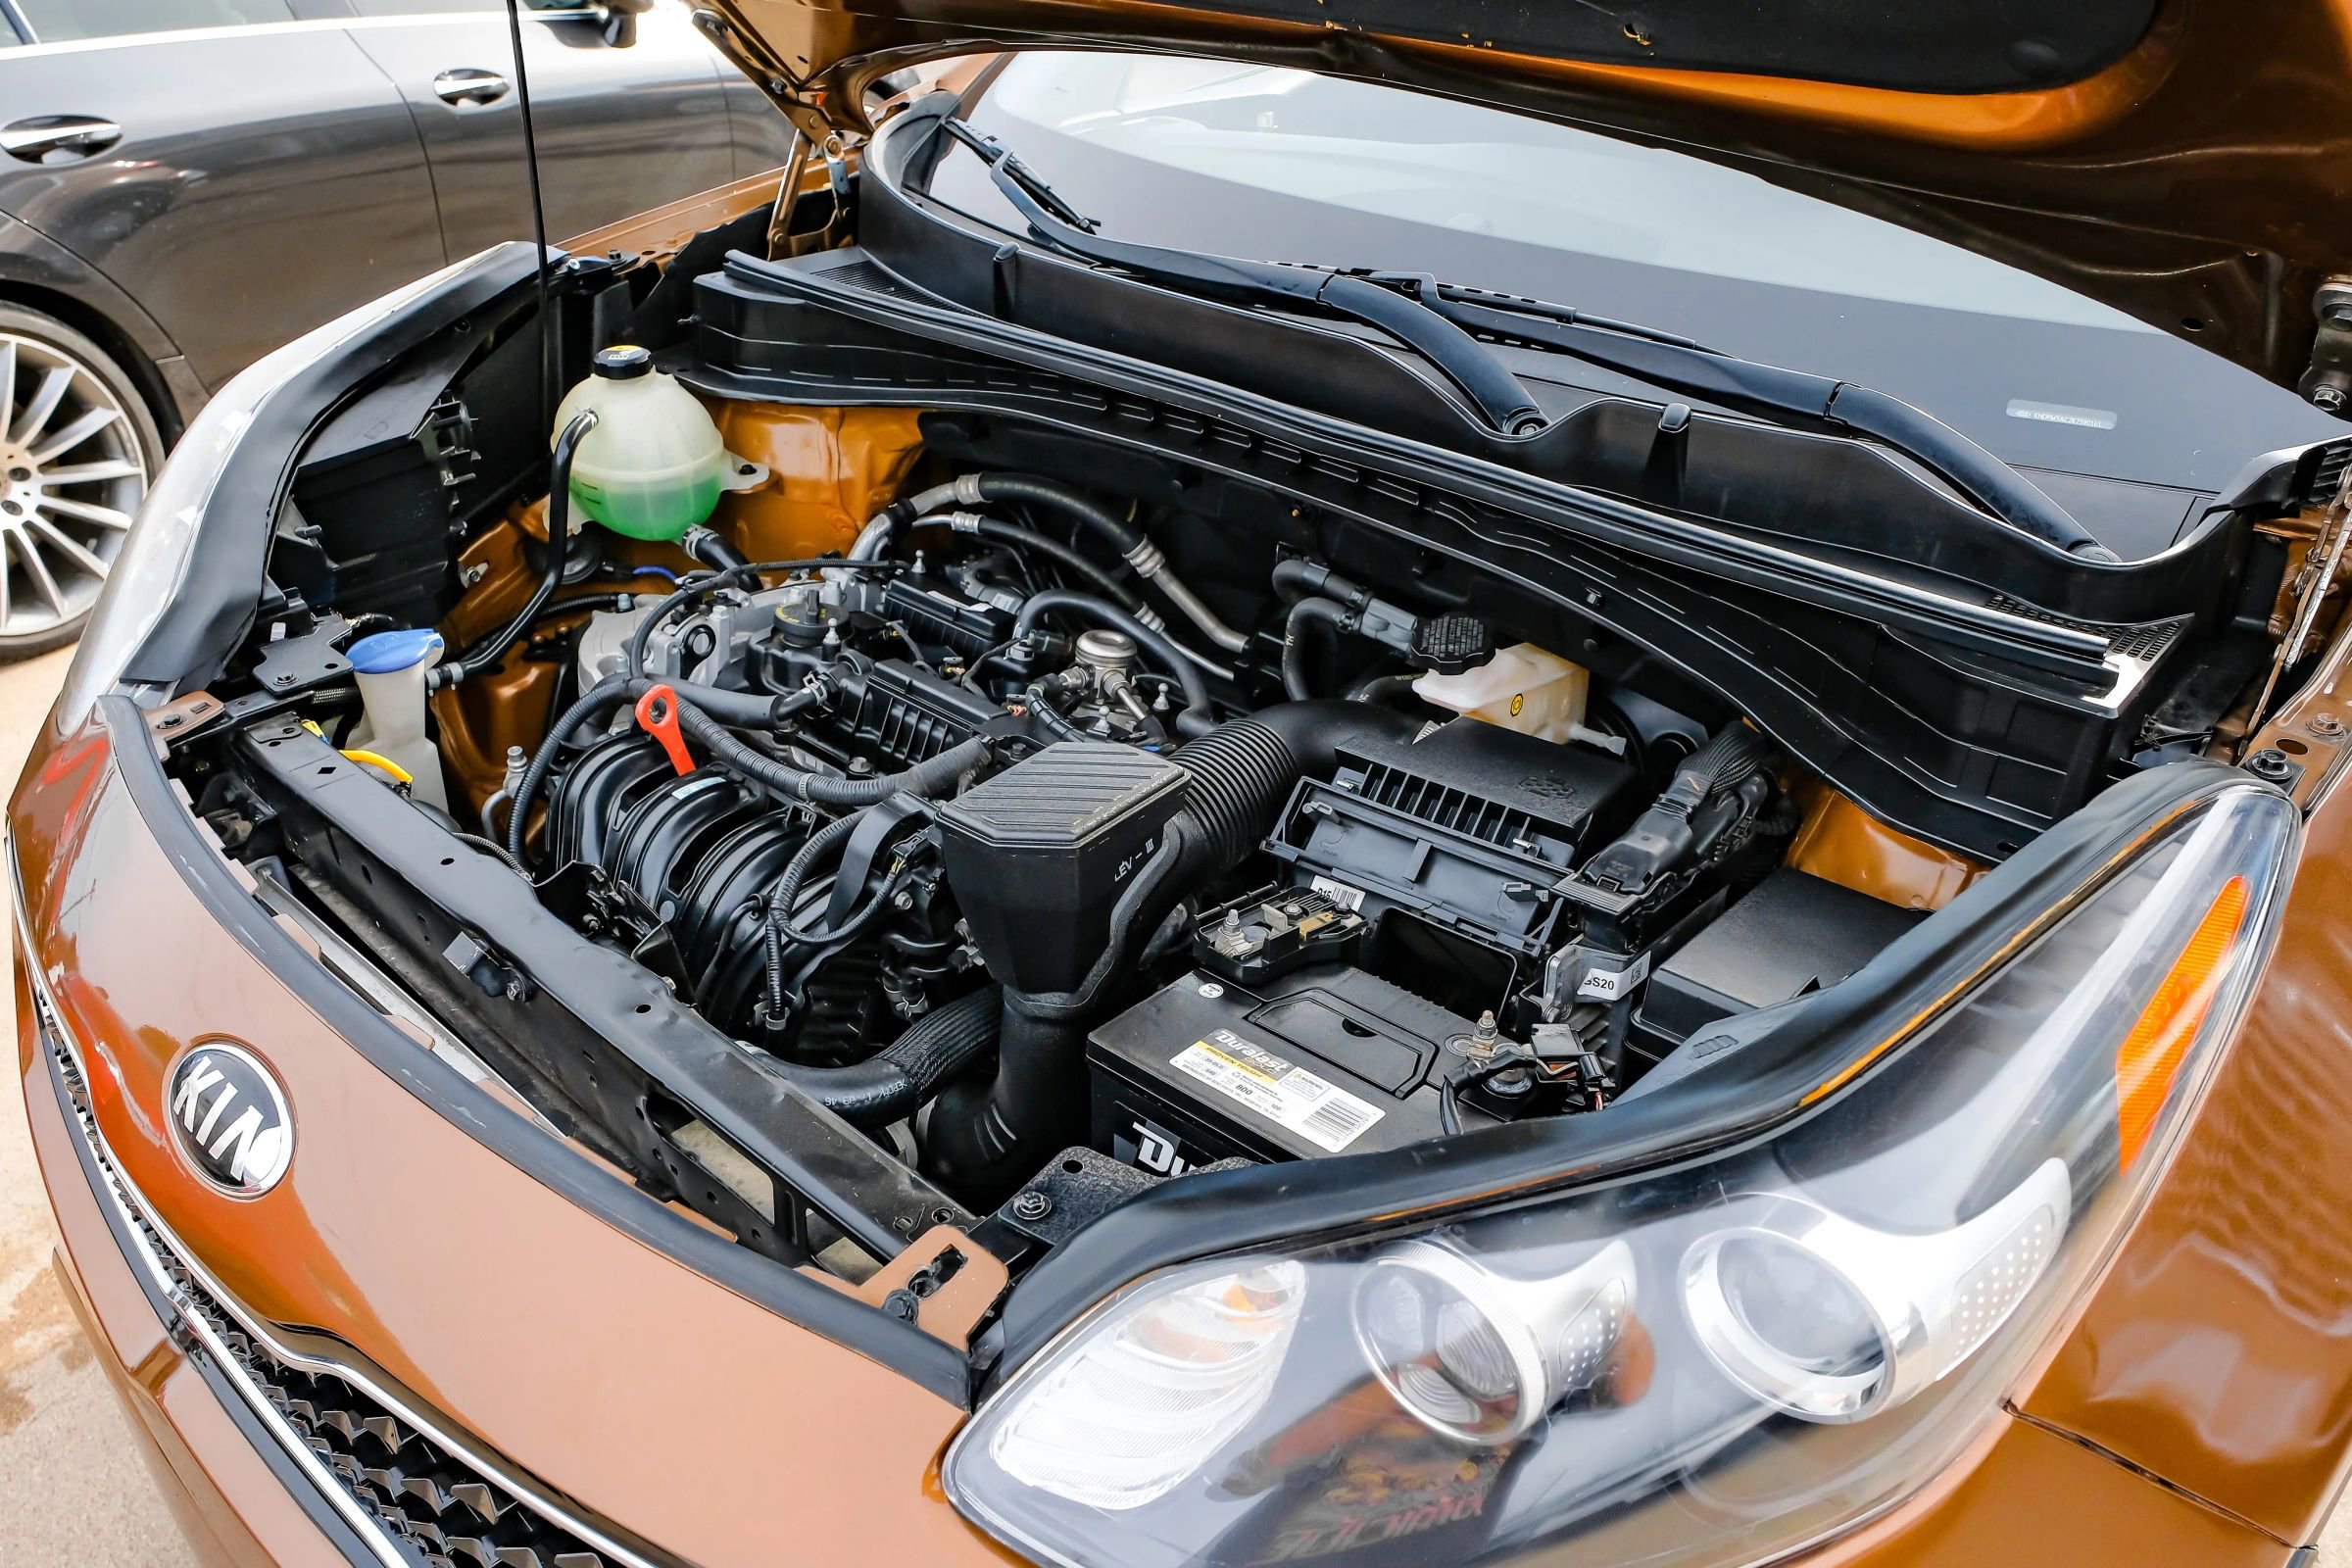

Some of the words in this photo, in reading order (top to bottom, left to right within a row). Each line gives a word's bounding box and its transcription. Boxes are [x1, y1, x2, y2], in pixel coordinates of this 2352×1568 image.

[1114, 856, 1133, 882] LEV
[1205, 1047, 1237, 1064] PROVEN
[1238, 1062, 1264, 1078] TOUGH
[1214, 1030, 1290, 1072] Duralast
[1235, 1084, 1253, 1096] 800
[172, 1054, 265, 1181] KIA
